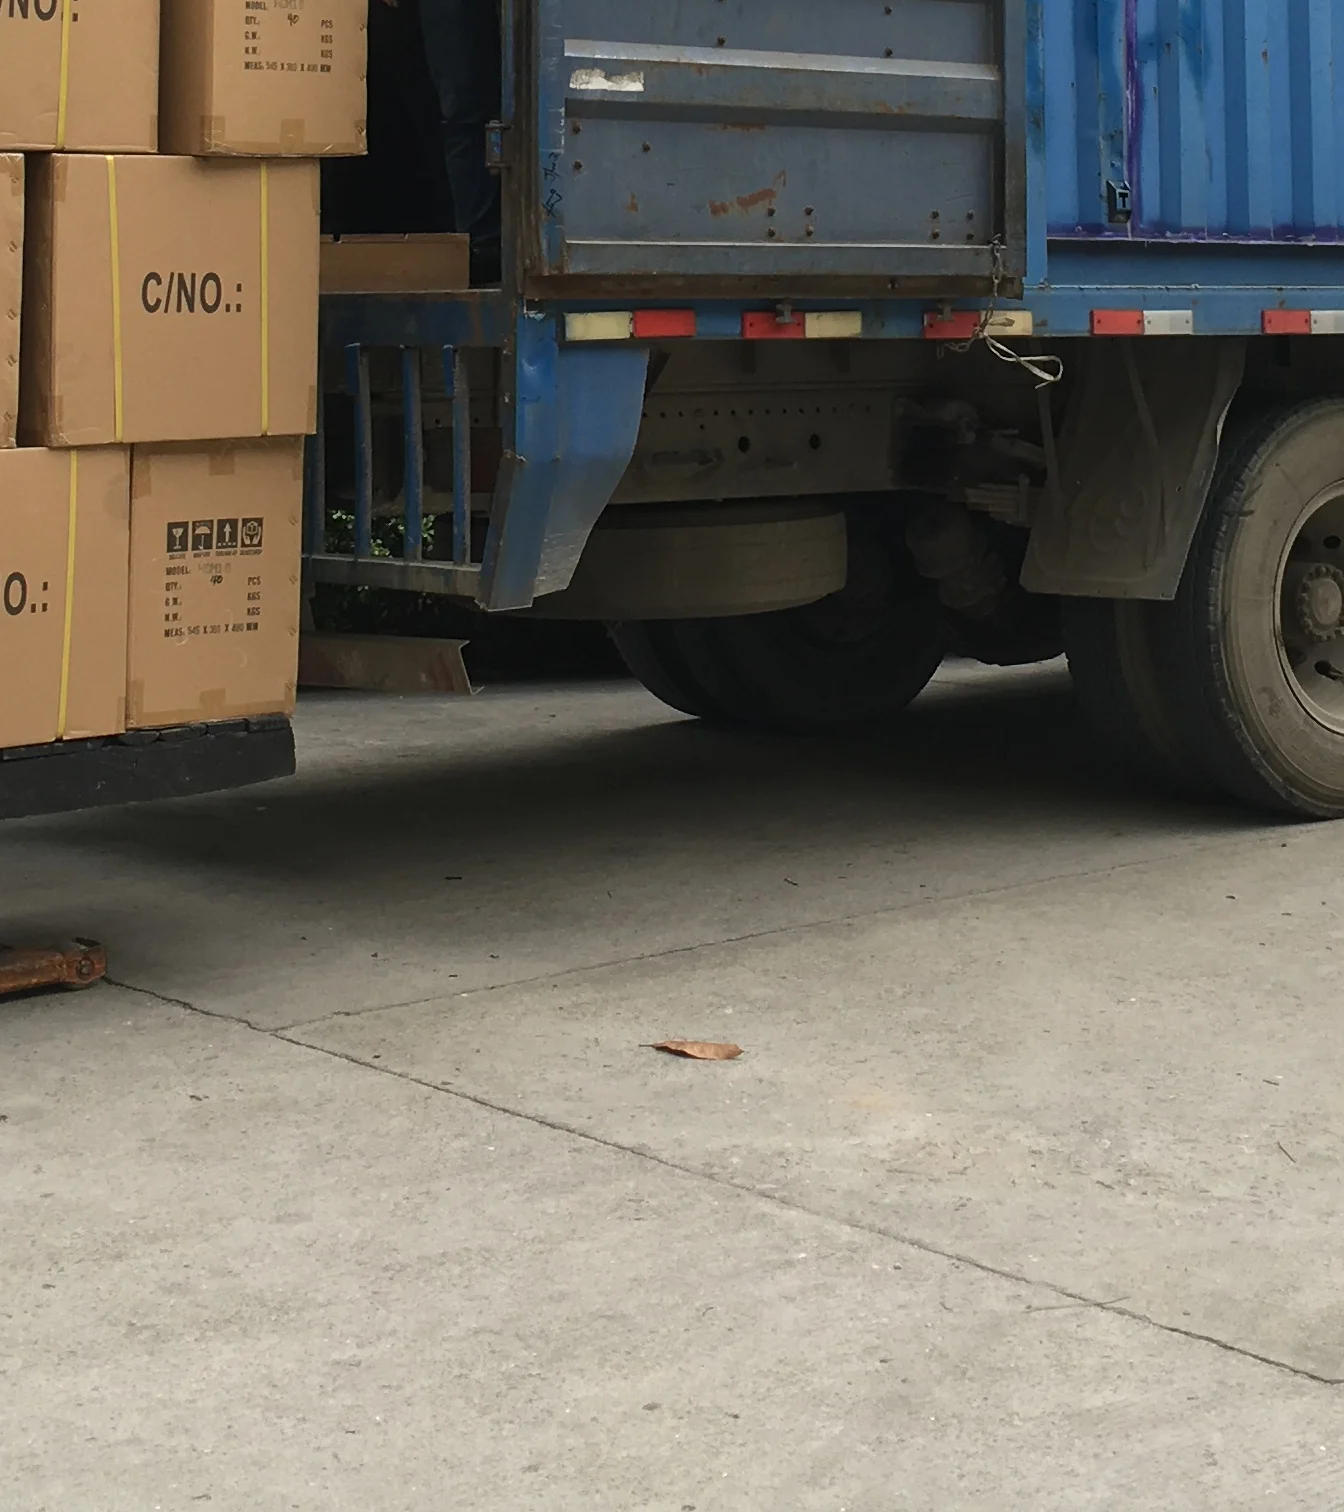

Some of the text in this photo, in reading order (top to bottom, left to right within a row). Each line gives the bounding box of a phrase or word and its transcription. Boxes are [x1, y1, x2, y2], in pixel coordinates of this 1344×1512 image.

[320, 19, 333, 28] PCS
[142, 272, 242, 314] C/NO.:
[247, 576, 261, 586] PCS
[203, 625, 208, 634] X
[224, 623, 229, 632] X
